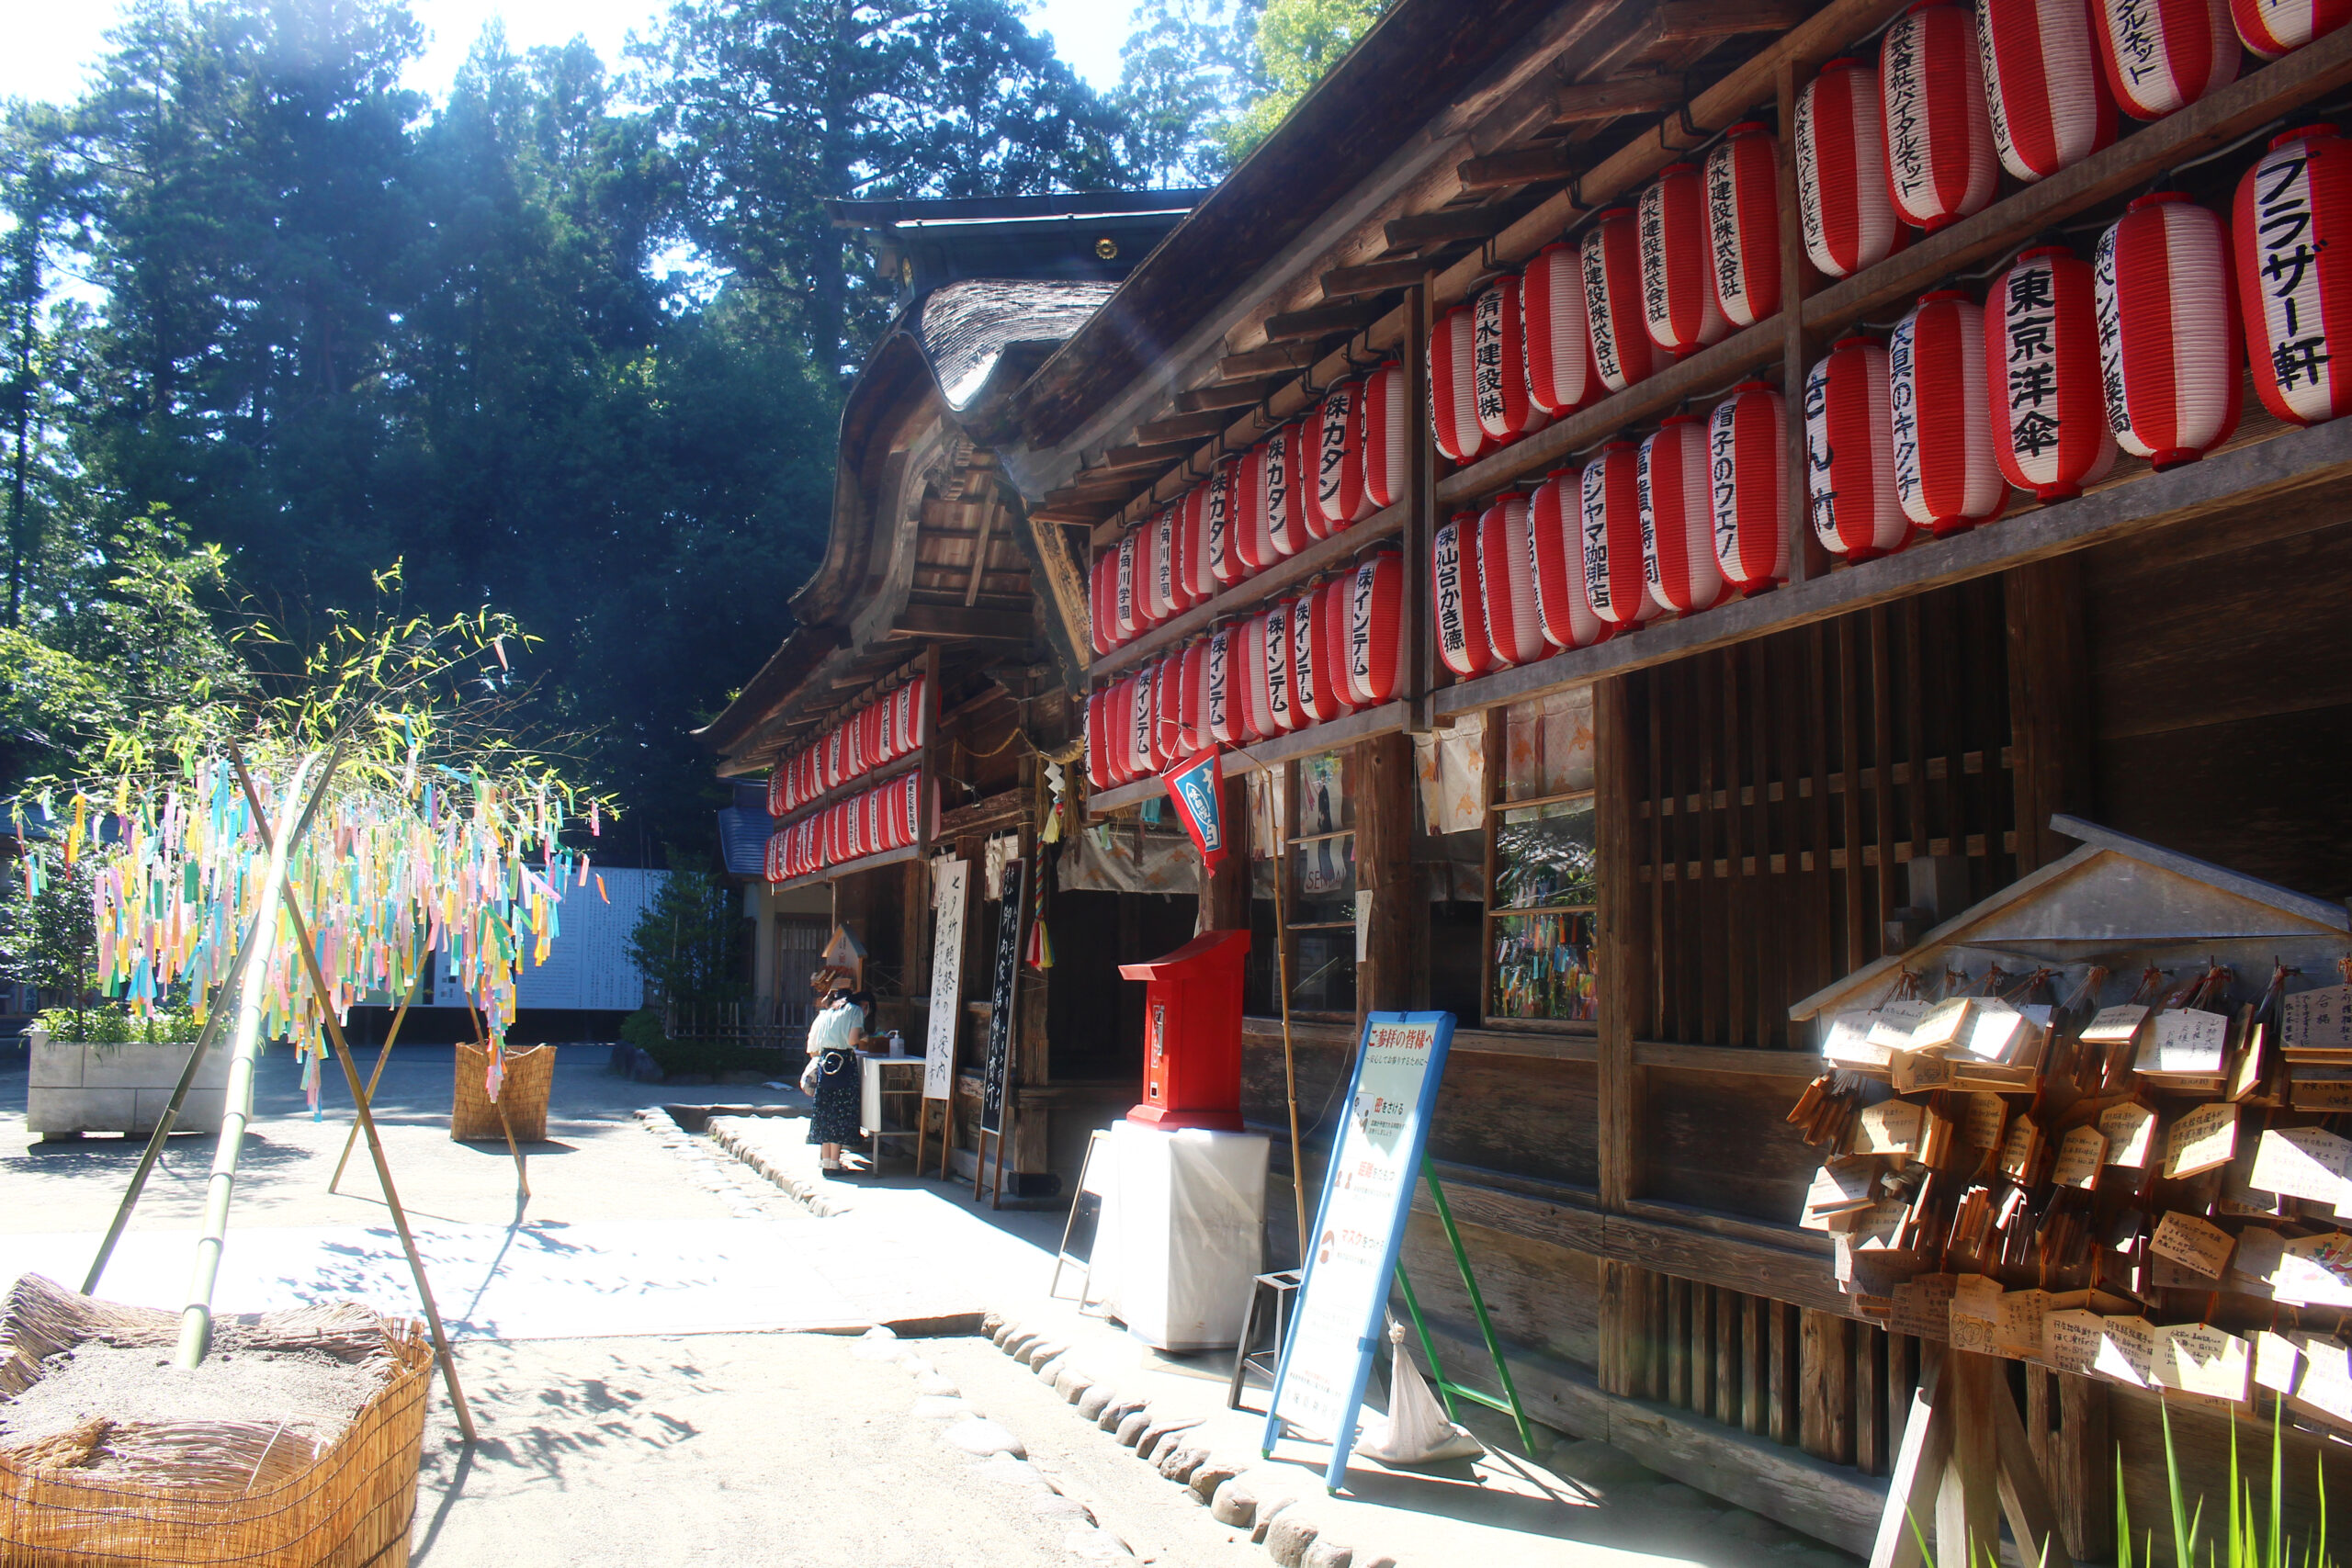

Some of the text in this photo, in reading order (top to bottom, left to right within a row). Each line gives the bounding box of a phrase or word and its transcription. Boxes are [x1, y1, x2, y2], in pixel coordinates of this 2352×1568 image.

[1890, 19, 1922, 198] 株式会社バイタルネット
[1639, 186, 1668, 323] 清水建設株式会社
[1708, 144, 1743, 300] 清水建設株式会社
[2256, 149, 2333, 392] ブラザー軒
[1582, 230, 1620, 379] 清水建設株式会社
[2006, 269, 2061, 457] 東京洋傘
[1712, 404, 1737, 558] 帽子のウエノ
[1891, 321, 1919, 502] 文具のキクチ
[1582, 460, 1611, 609] ホシヤマ珈琲店
[1368, 1028, 1433, 1050] ご参拝の皆様へ
[1374, 1097, 1404, 1115] 密をさける
